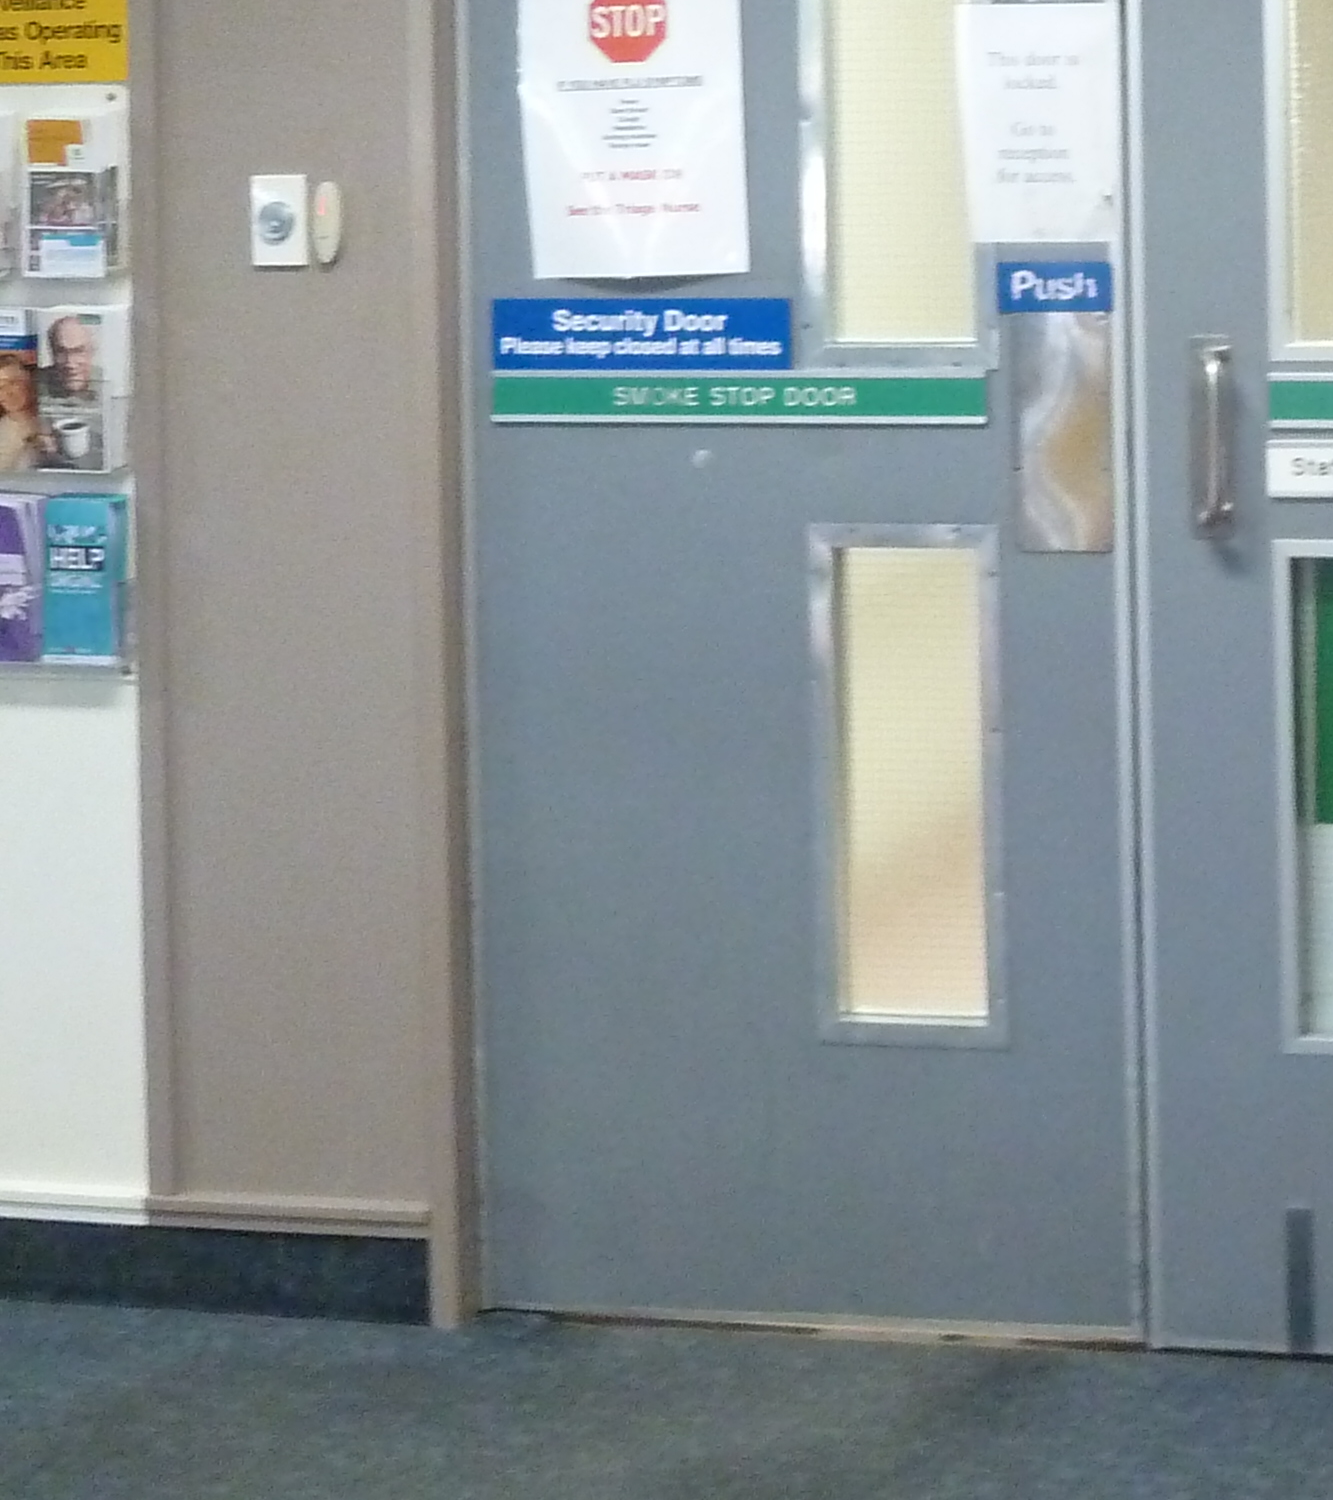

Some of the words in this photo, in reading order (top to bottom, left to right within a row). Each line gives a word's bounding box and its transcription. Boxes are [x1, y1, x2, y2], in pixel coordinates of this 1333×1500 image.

[24, 20, 122, 45] Operating
[589, 4, 667, 38] STOP
[39, 51, 88, 70] Area
[996, 167, 1020, 183] for
[1010, 269, 1099, 301] Push
[552, 309, 660, 337] Security
[663, 309, 729, 332] Door
[500, 336, 564, 355] Please
[566, 336, 612, 359] keep
[614, 336, 677, 355] closed
[679, 338, 701, 355] at
[702, 337, 727, 355] all
[728, 336, 783, 356] times
[612, 386, 700, 407] SMOKE
[709, 386, 776, 407] STOP
[783, 386, 858, 407] DOOR
